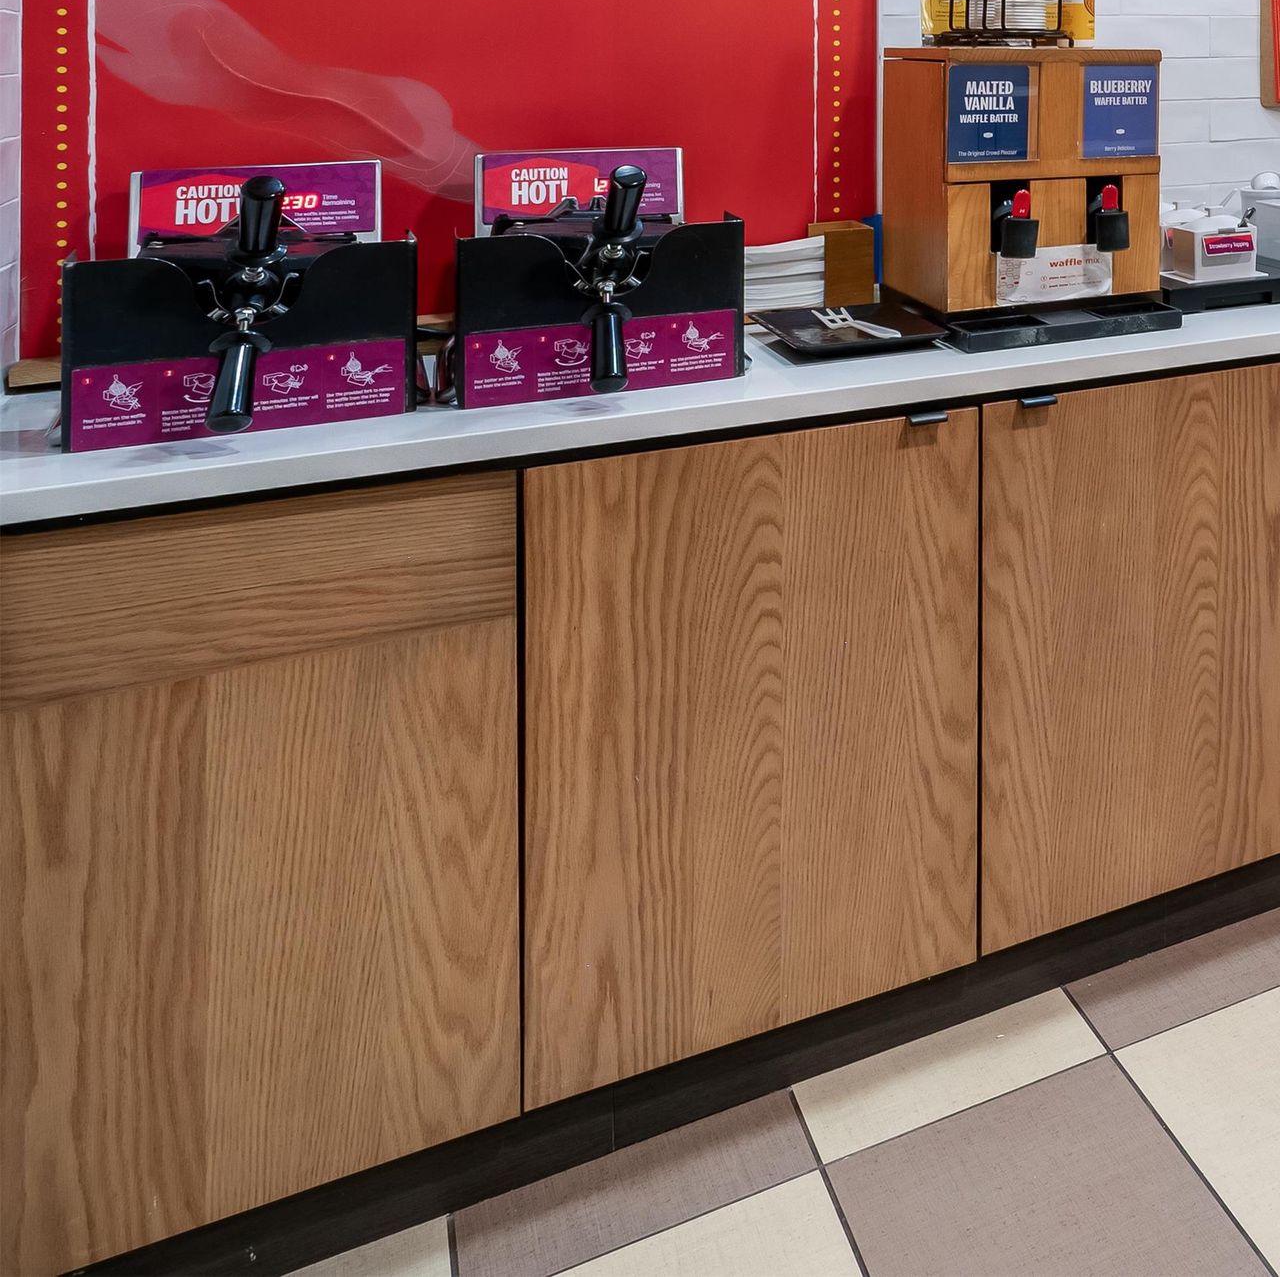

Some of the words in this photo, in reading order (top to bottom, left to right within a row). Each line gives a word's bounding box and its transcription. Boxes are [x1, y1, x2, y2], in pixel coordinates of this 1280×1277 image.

[965, 81, 1014, 95] MALTED
[1089, 79, 1152, 94] BLUEBERRY
[964, 96, 1015, 111] VANILLA
[1094, 96, 1121, 106] WAFFLE
[1122, 96, 1148, 105] BATTER
[959, 114, 989, 124] WAFFLE
[989, 113, 1018, 123] BATTER
[967, 150, 986, 158] Original
[511, 167, 568, 181] CAUTION
[176, 184, 243, 199] CAUTION
[511, 179, 568, 206] HOT!
[1209, 242, 1233, 250] Strawberry
[1049, 258, 1083, 268] waffle
